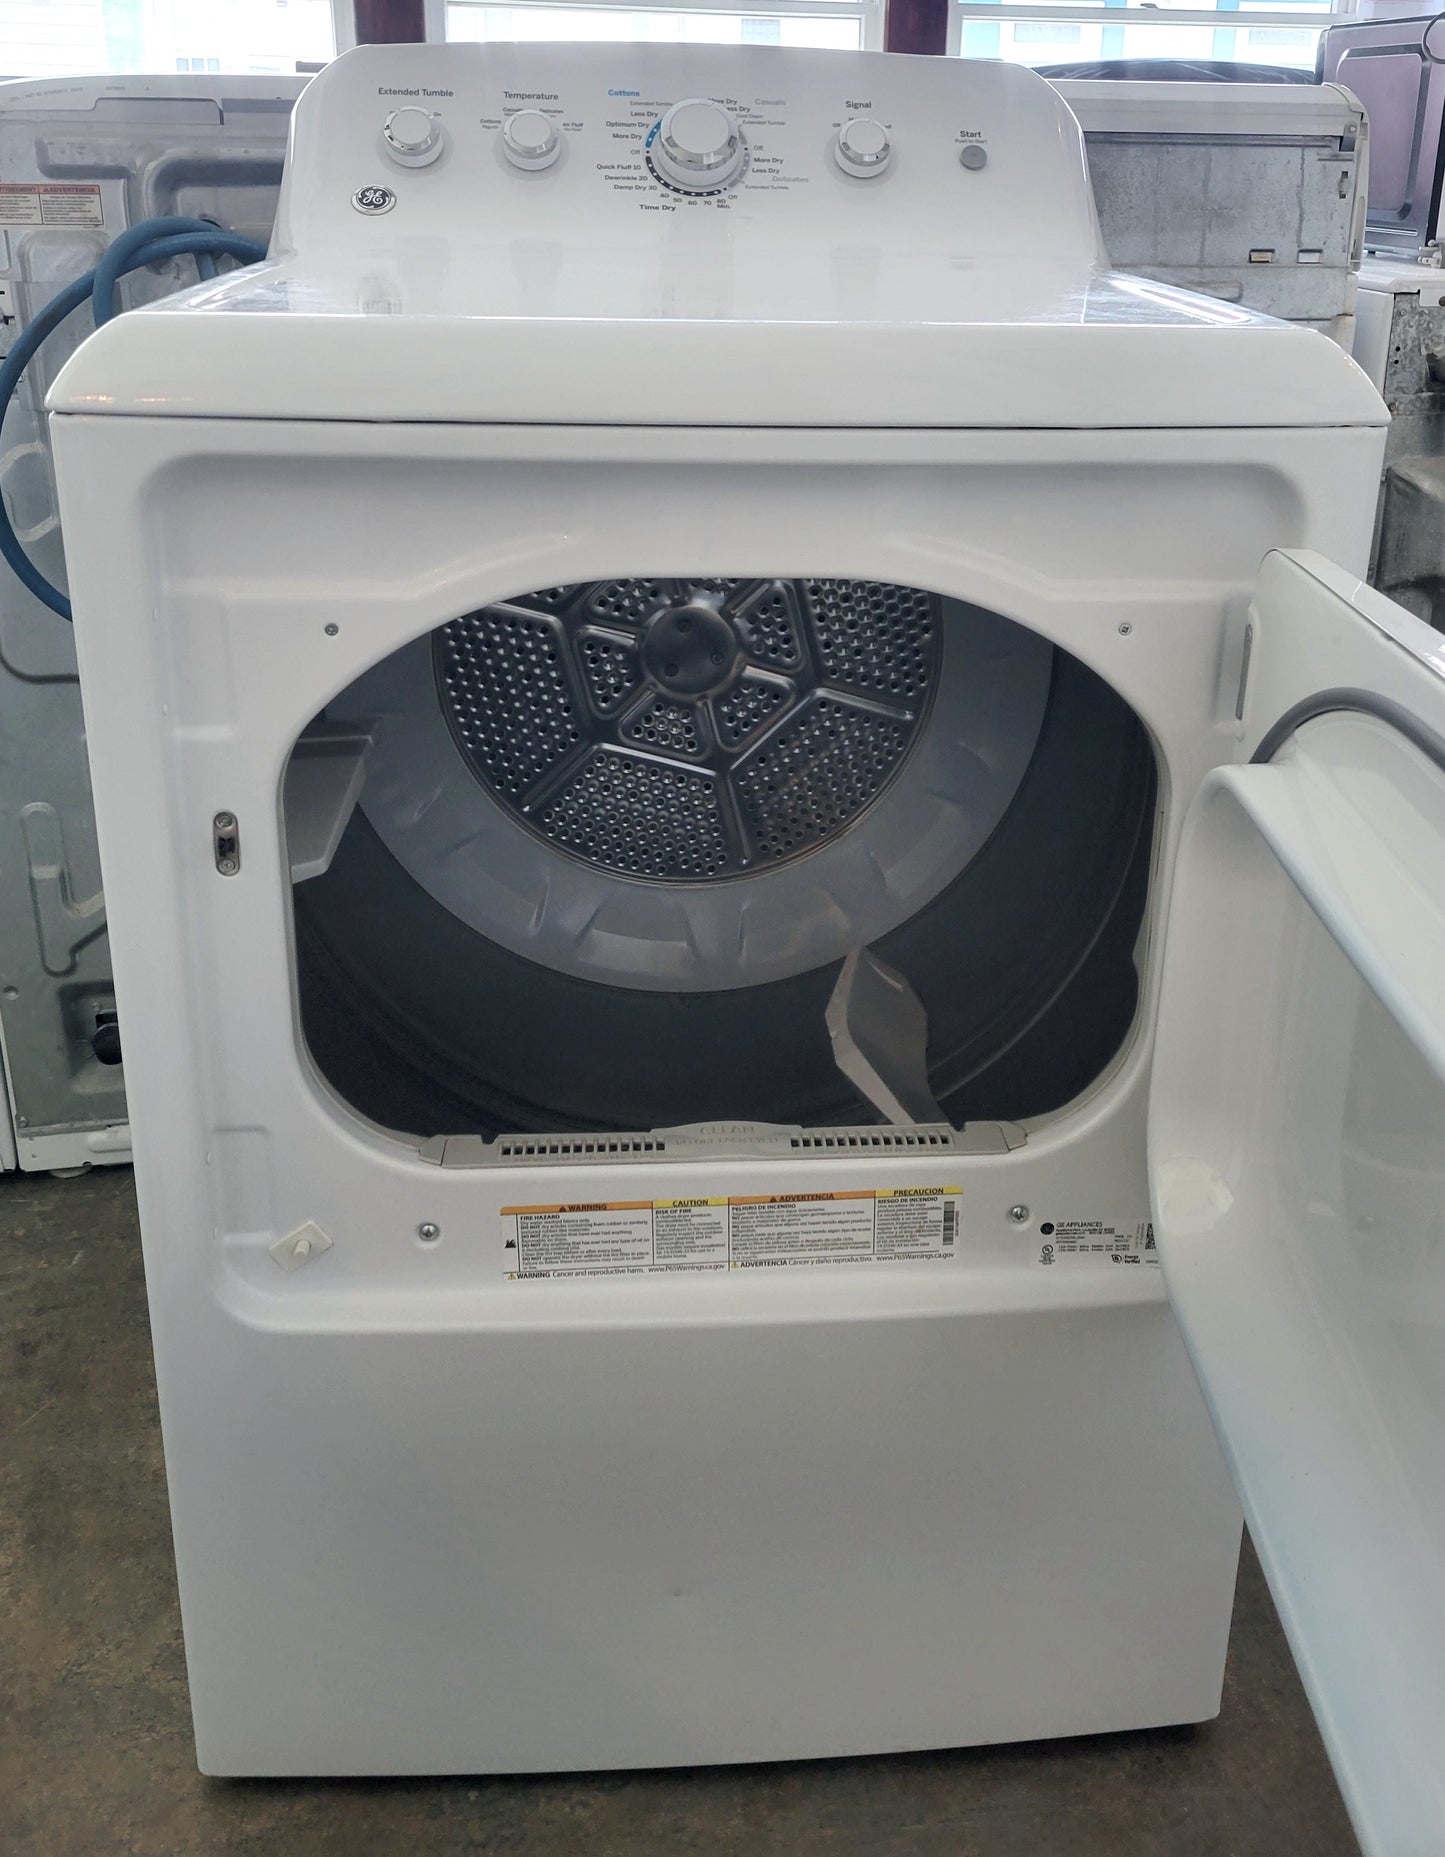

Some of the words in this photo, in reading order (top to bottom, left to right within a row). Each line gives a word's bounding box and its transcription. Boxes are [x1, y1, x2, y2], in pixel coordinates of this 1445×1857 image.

[378, 87, 420, 96] Extended
[422, 88, 454, 98] Tumble
[503, 90, 559, 101] Temperature
[608, 89, 640, 97] Cottons
[845, 100, 872, 110] Signal
[700, 1126, 754, 1135] CLEAN
[893, 1188, 944, 1197] PRECAUCION
[780, 1193, 835, 1202] ADVERTENCIA
[568, 1204, 607, 1212] WARNING
[588, 1267, 626, 1276] reproductive
